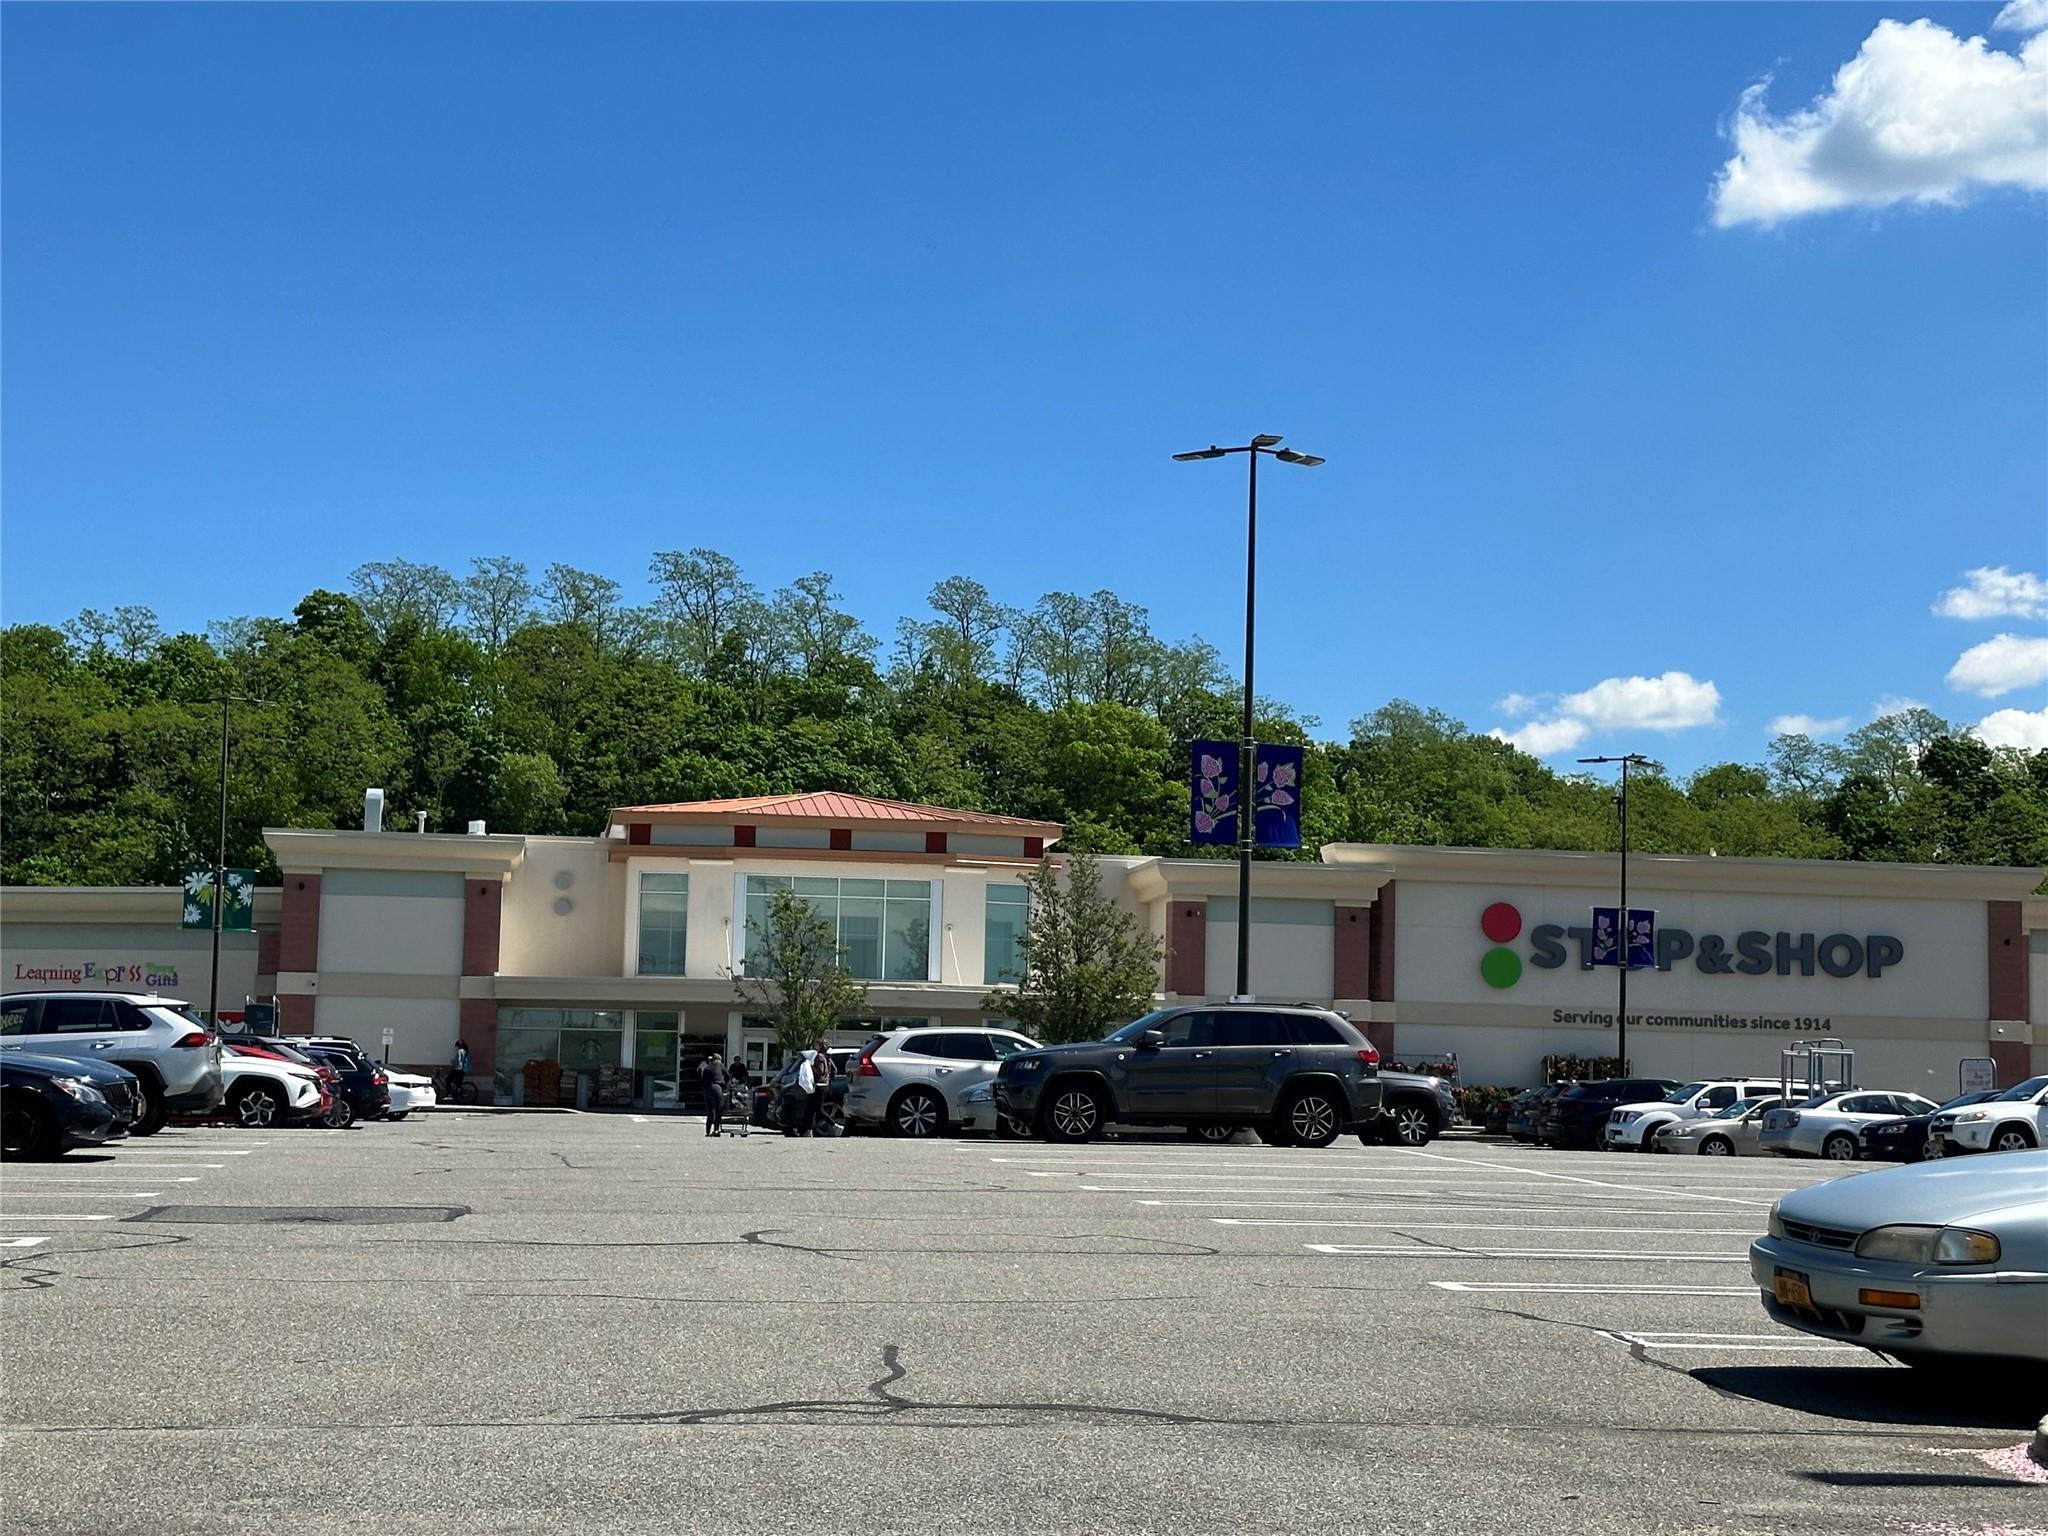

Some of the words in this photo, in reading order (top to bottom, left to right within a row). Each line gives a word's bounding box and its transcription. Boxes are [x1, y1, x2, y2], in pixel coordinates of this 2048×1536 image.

[1530, 923, 1904, 978] STP&SHOP
[15, 963, 81, 984] Learning
[145, 973, 179, 987] Gifts
[1553, 1009, 1613, 1028] Serving
[1617, 1014, 1642, 1026] ur
[1645, 1013, 1748, 1029] communities
[1750, 1015, 1791, 1030] since
[1794, 1017, 1832, 1031] 1914
